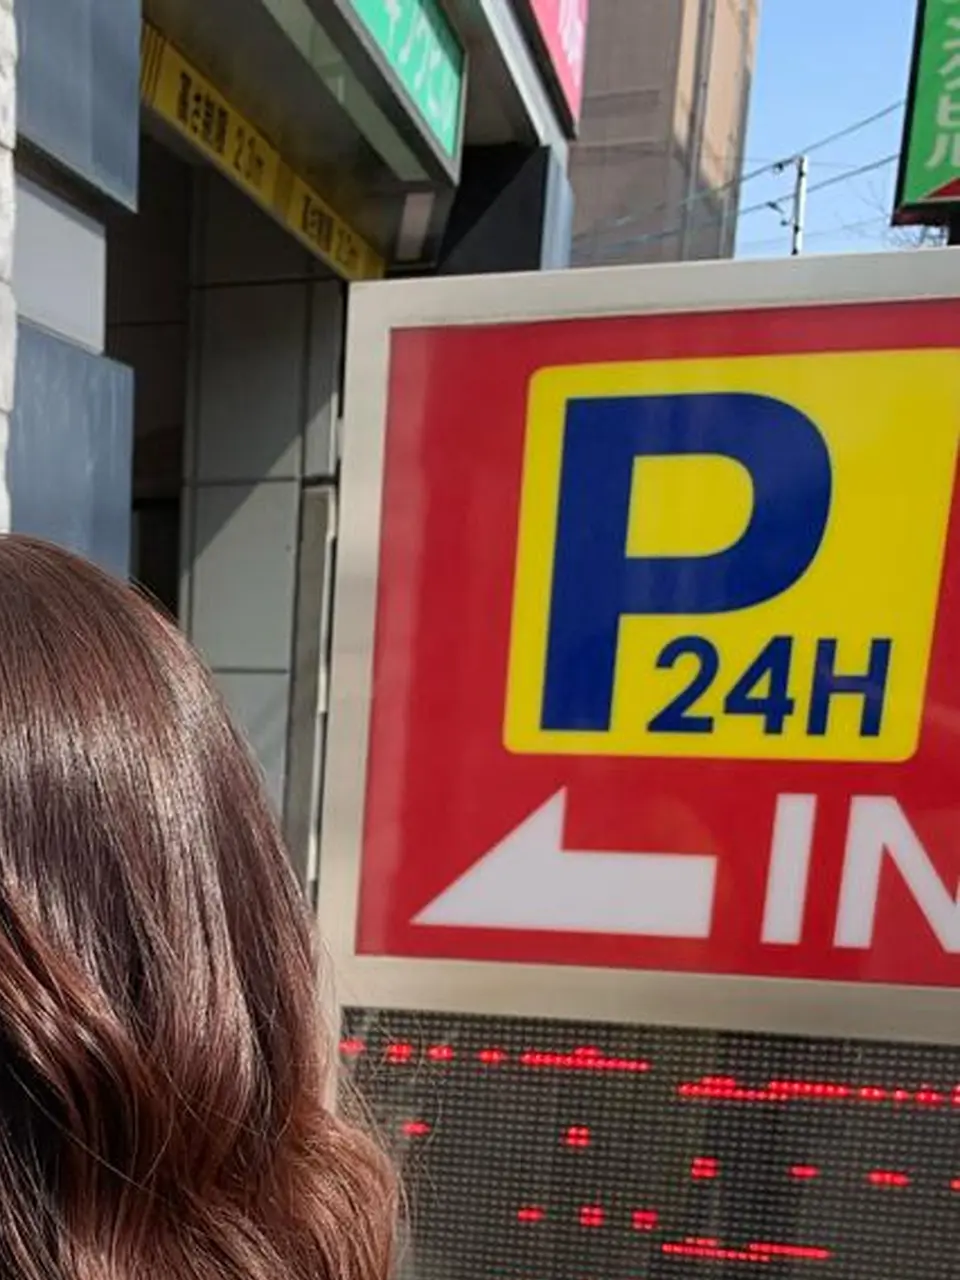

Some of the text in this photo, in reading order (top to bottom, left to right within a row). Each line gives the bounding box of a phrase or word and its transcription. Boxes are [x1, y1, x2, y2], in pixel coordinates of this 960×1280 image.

[540, 391, 833, 732] P
[647, 635, 892, 737] 24H
[760, 792, 960, 954] IN
